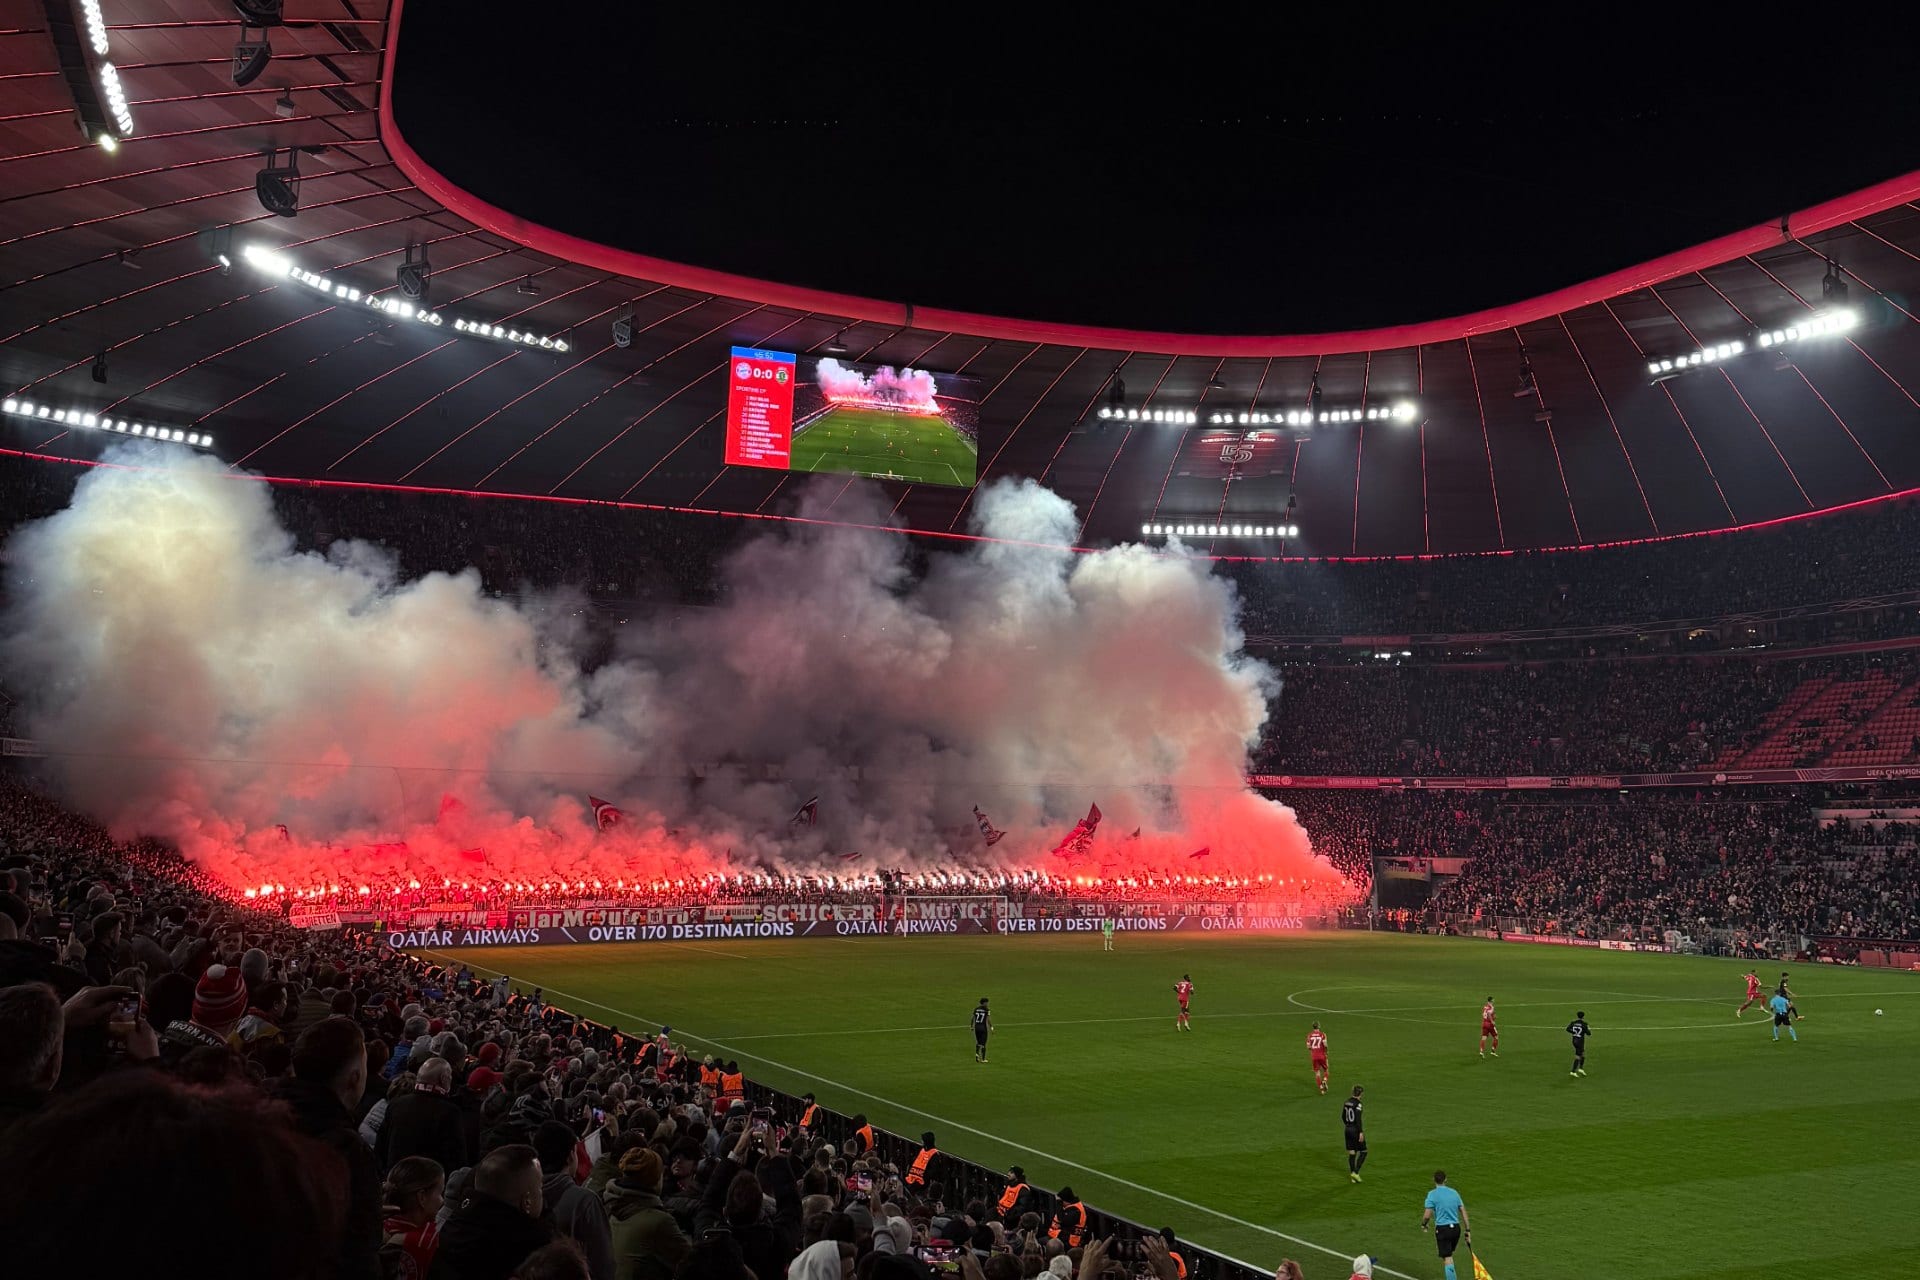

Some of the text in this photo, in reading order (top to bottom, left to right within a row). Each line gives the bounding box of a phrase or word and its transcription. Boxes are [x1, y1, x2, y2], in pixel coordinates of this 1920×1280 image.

[753, 368, 773, 379] 0:0
[1219, 444, 1255, 463] 5
[836, 919, 957, 935] QATAR AIRWAYS
[997, 918, 1036, 933] OVER
[1040, 918, 1062, 931] 170
[1201, 916, 1303, 931] QATAR AIRWAYS
[389, 928, 539, 948] QATAR AIRWAYS
[589, 922, 794, 942] OVER 170 DESTINATIONS
[1644, 944, 1663, 952] PEPSI
[975, 1012, 985, 1023] 27
[1572, 1026, 1583, 1037] 52
[1310, 1037, 1322, 1048] 27
